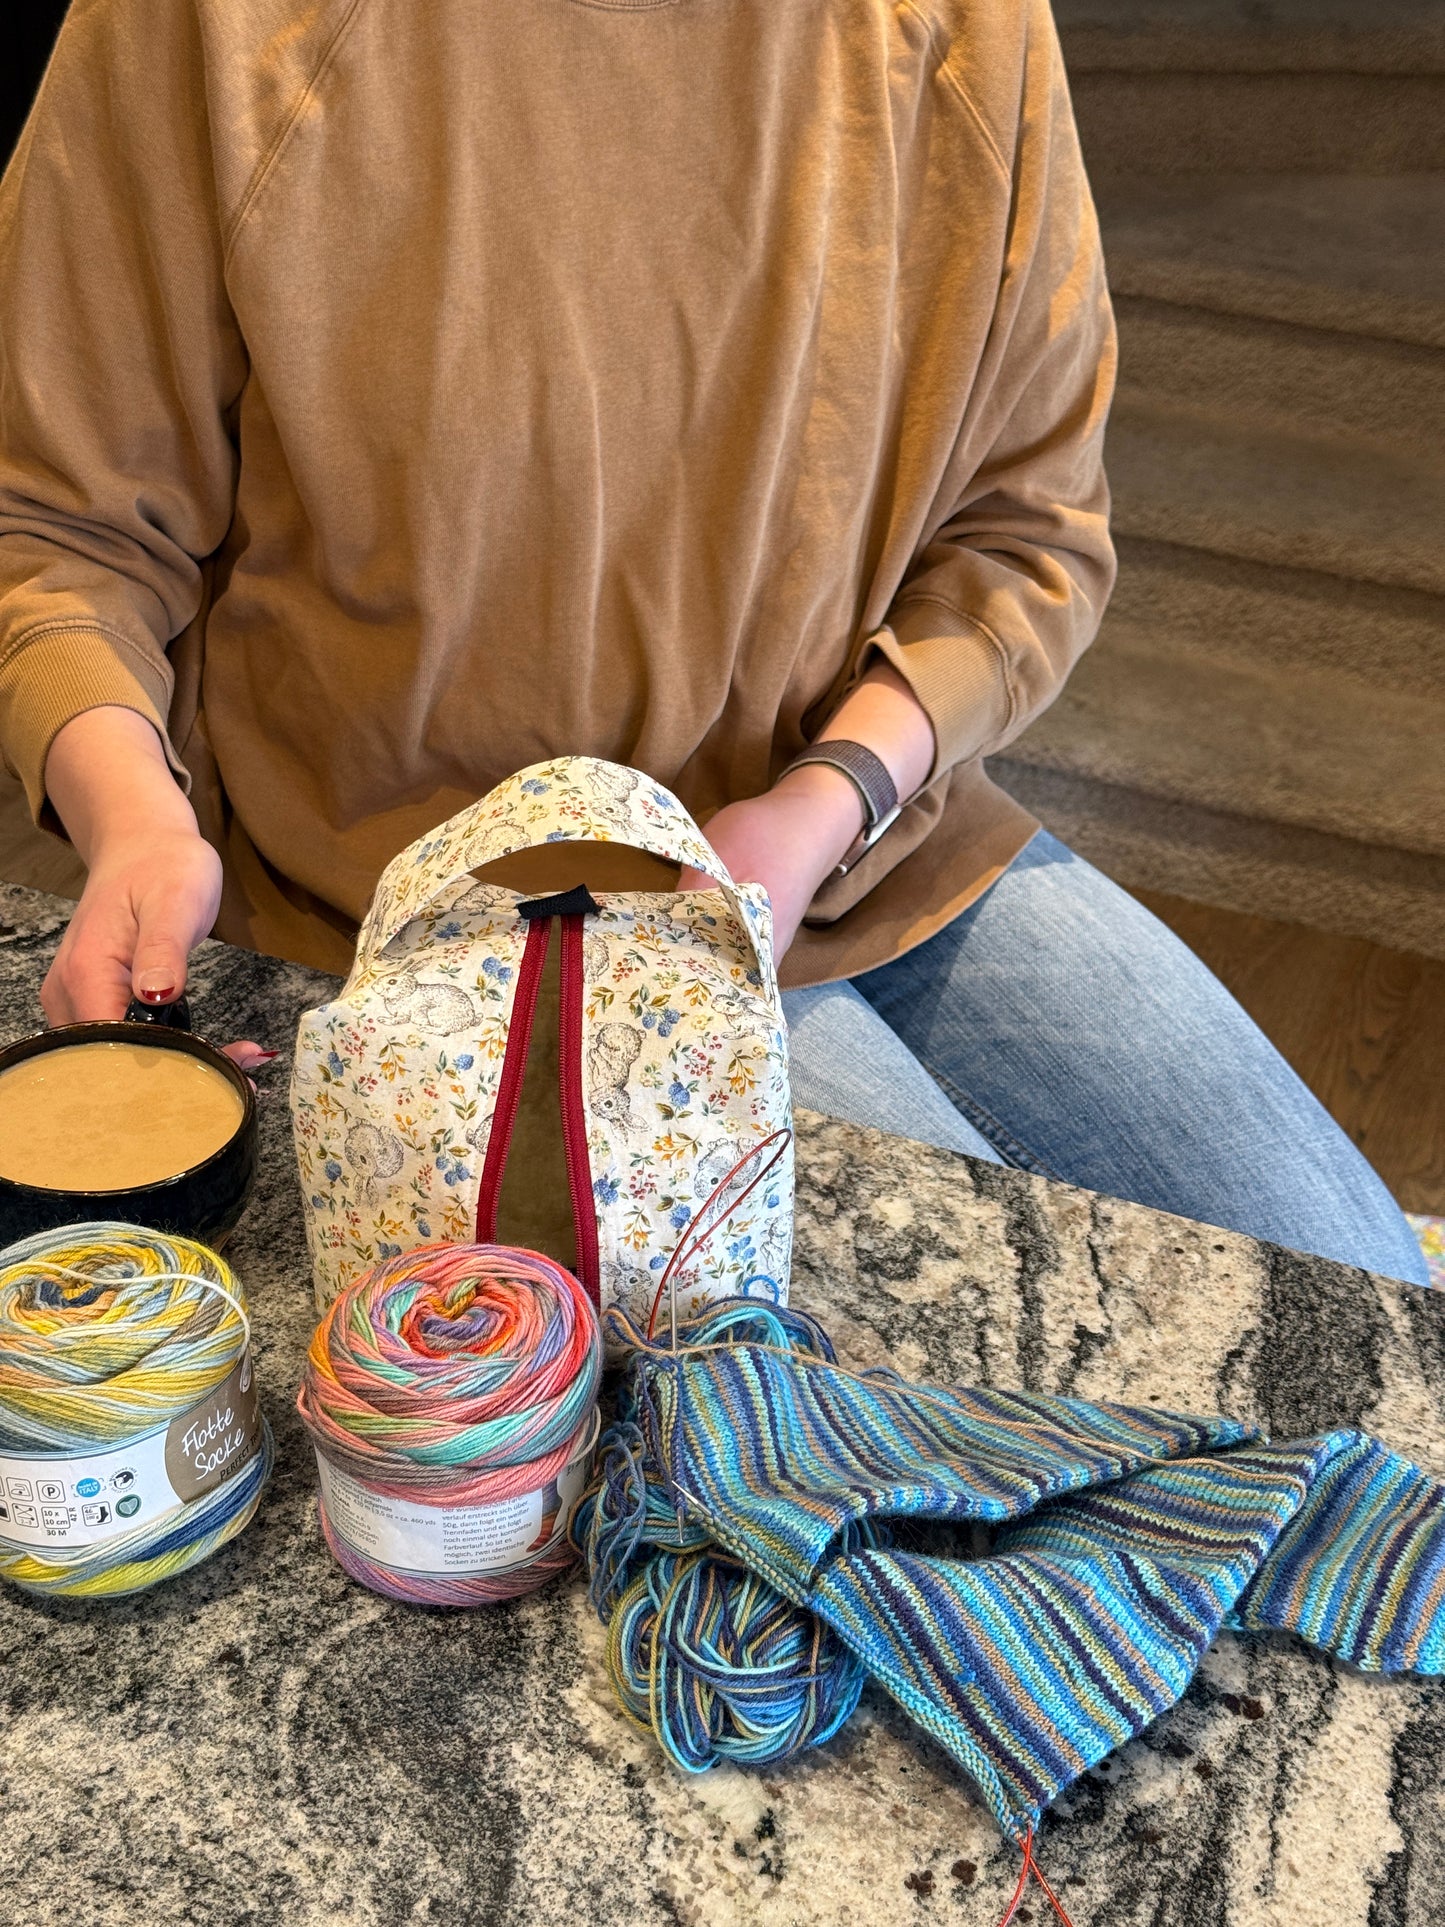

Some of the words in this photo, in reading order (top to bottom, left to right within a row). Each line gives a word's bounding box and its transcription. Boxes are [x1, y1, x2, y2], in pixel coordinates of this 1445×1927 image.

[182, 1407, 235, 1456] Flotte
[194, 1428, 245, 1480] Socke
[219, 1445, 250, 1480] PERFECT
[79, 1484, 99, 1494] ITALY
[442, 1513, 467, 1521] verlauf
[467, 1510, 498, 1519] erstreckt
[499, 1506, 513, 1515] sich
[513, 1500, 529, 1511] über
[460, 1520, 478, 1528] dann
[479, 1518, 495, 1526] folgt
[483, 1525, 498, 1533] und
[462, 1534, 486, 1542] einmal
[444, 1557, 469, 1566] Socken
